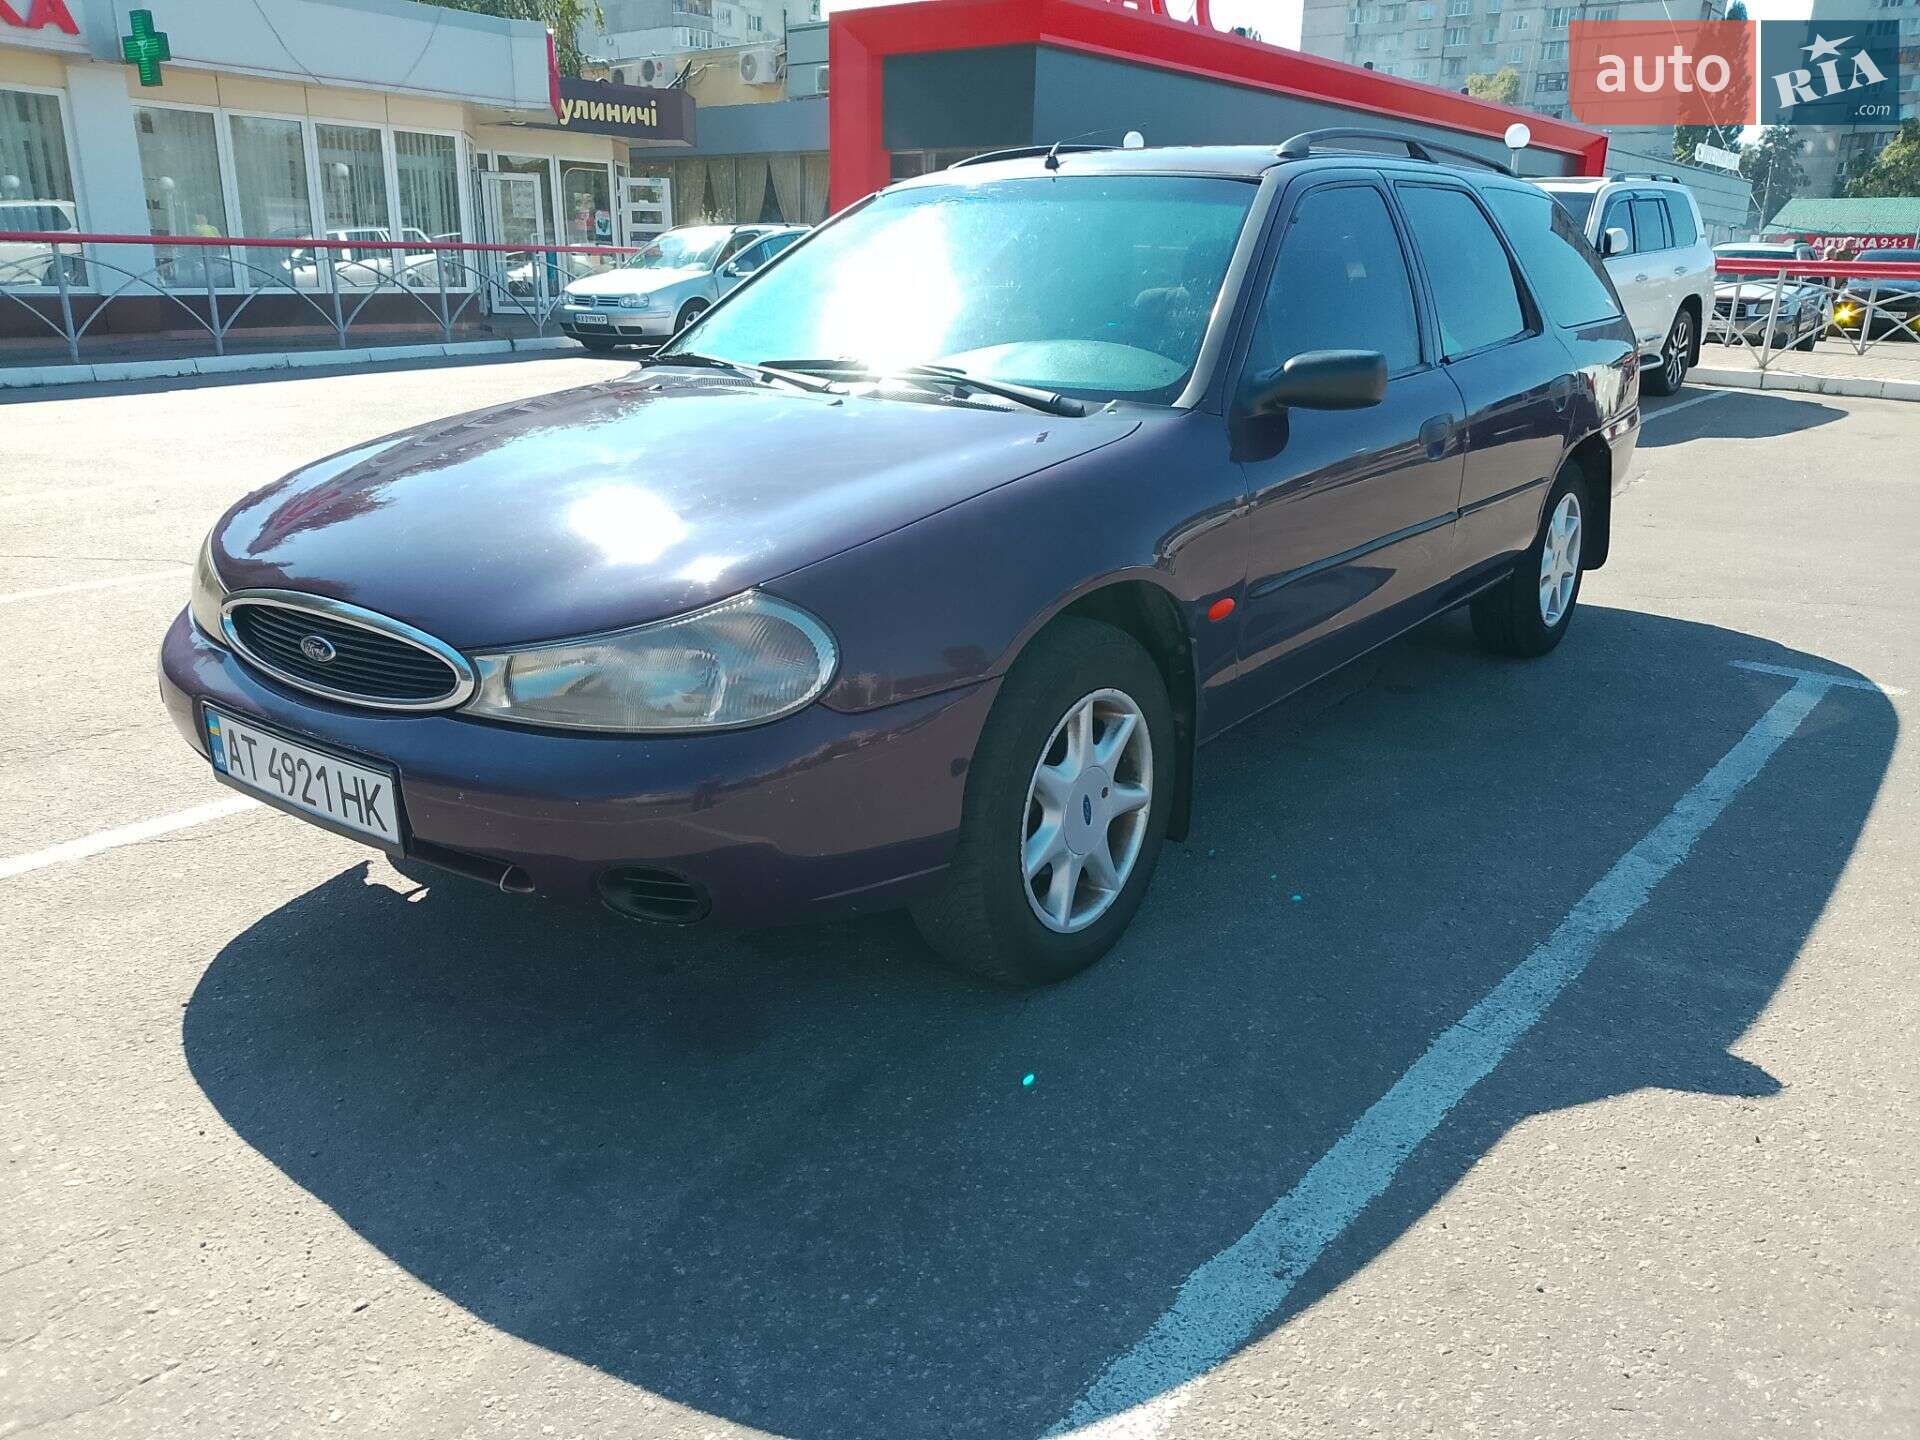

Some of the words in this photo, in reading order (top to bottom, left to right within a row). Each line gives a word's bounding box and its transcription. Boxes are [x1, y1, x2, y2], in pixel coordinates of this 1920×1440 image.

[559, 97, 657, 126] улиничі
[1812, 236, 1878, 249] АПТКА
[228, 729, 258, 782] AT
[268, 748, 333, 812] 4921
[337, 771, 388, 832] HK
